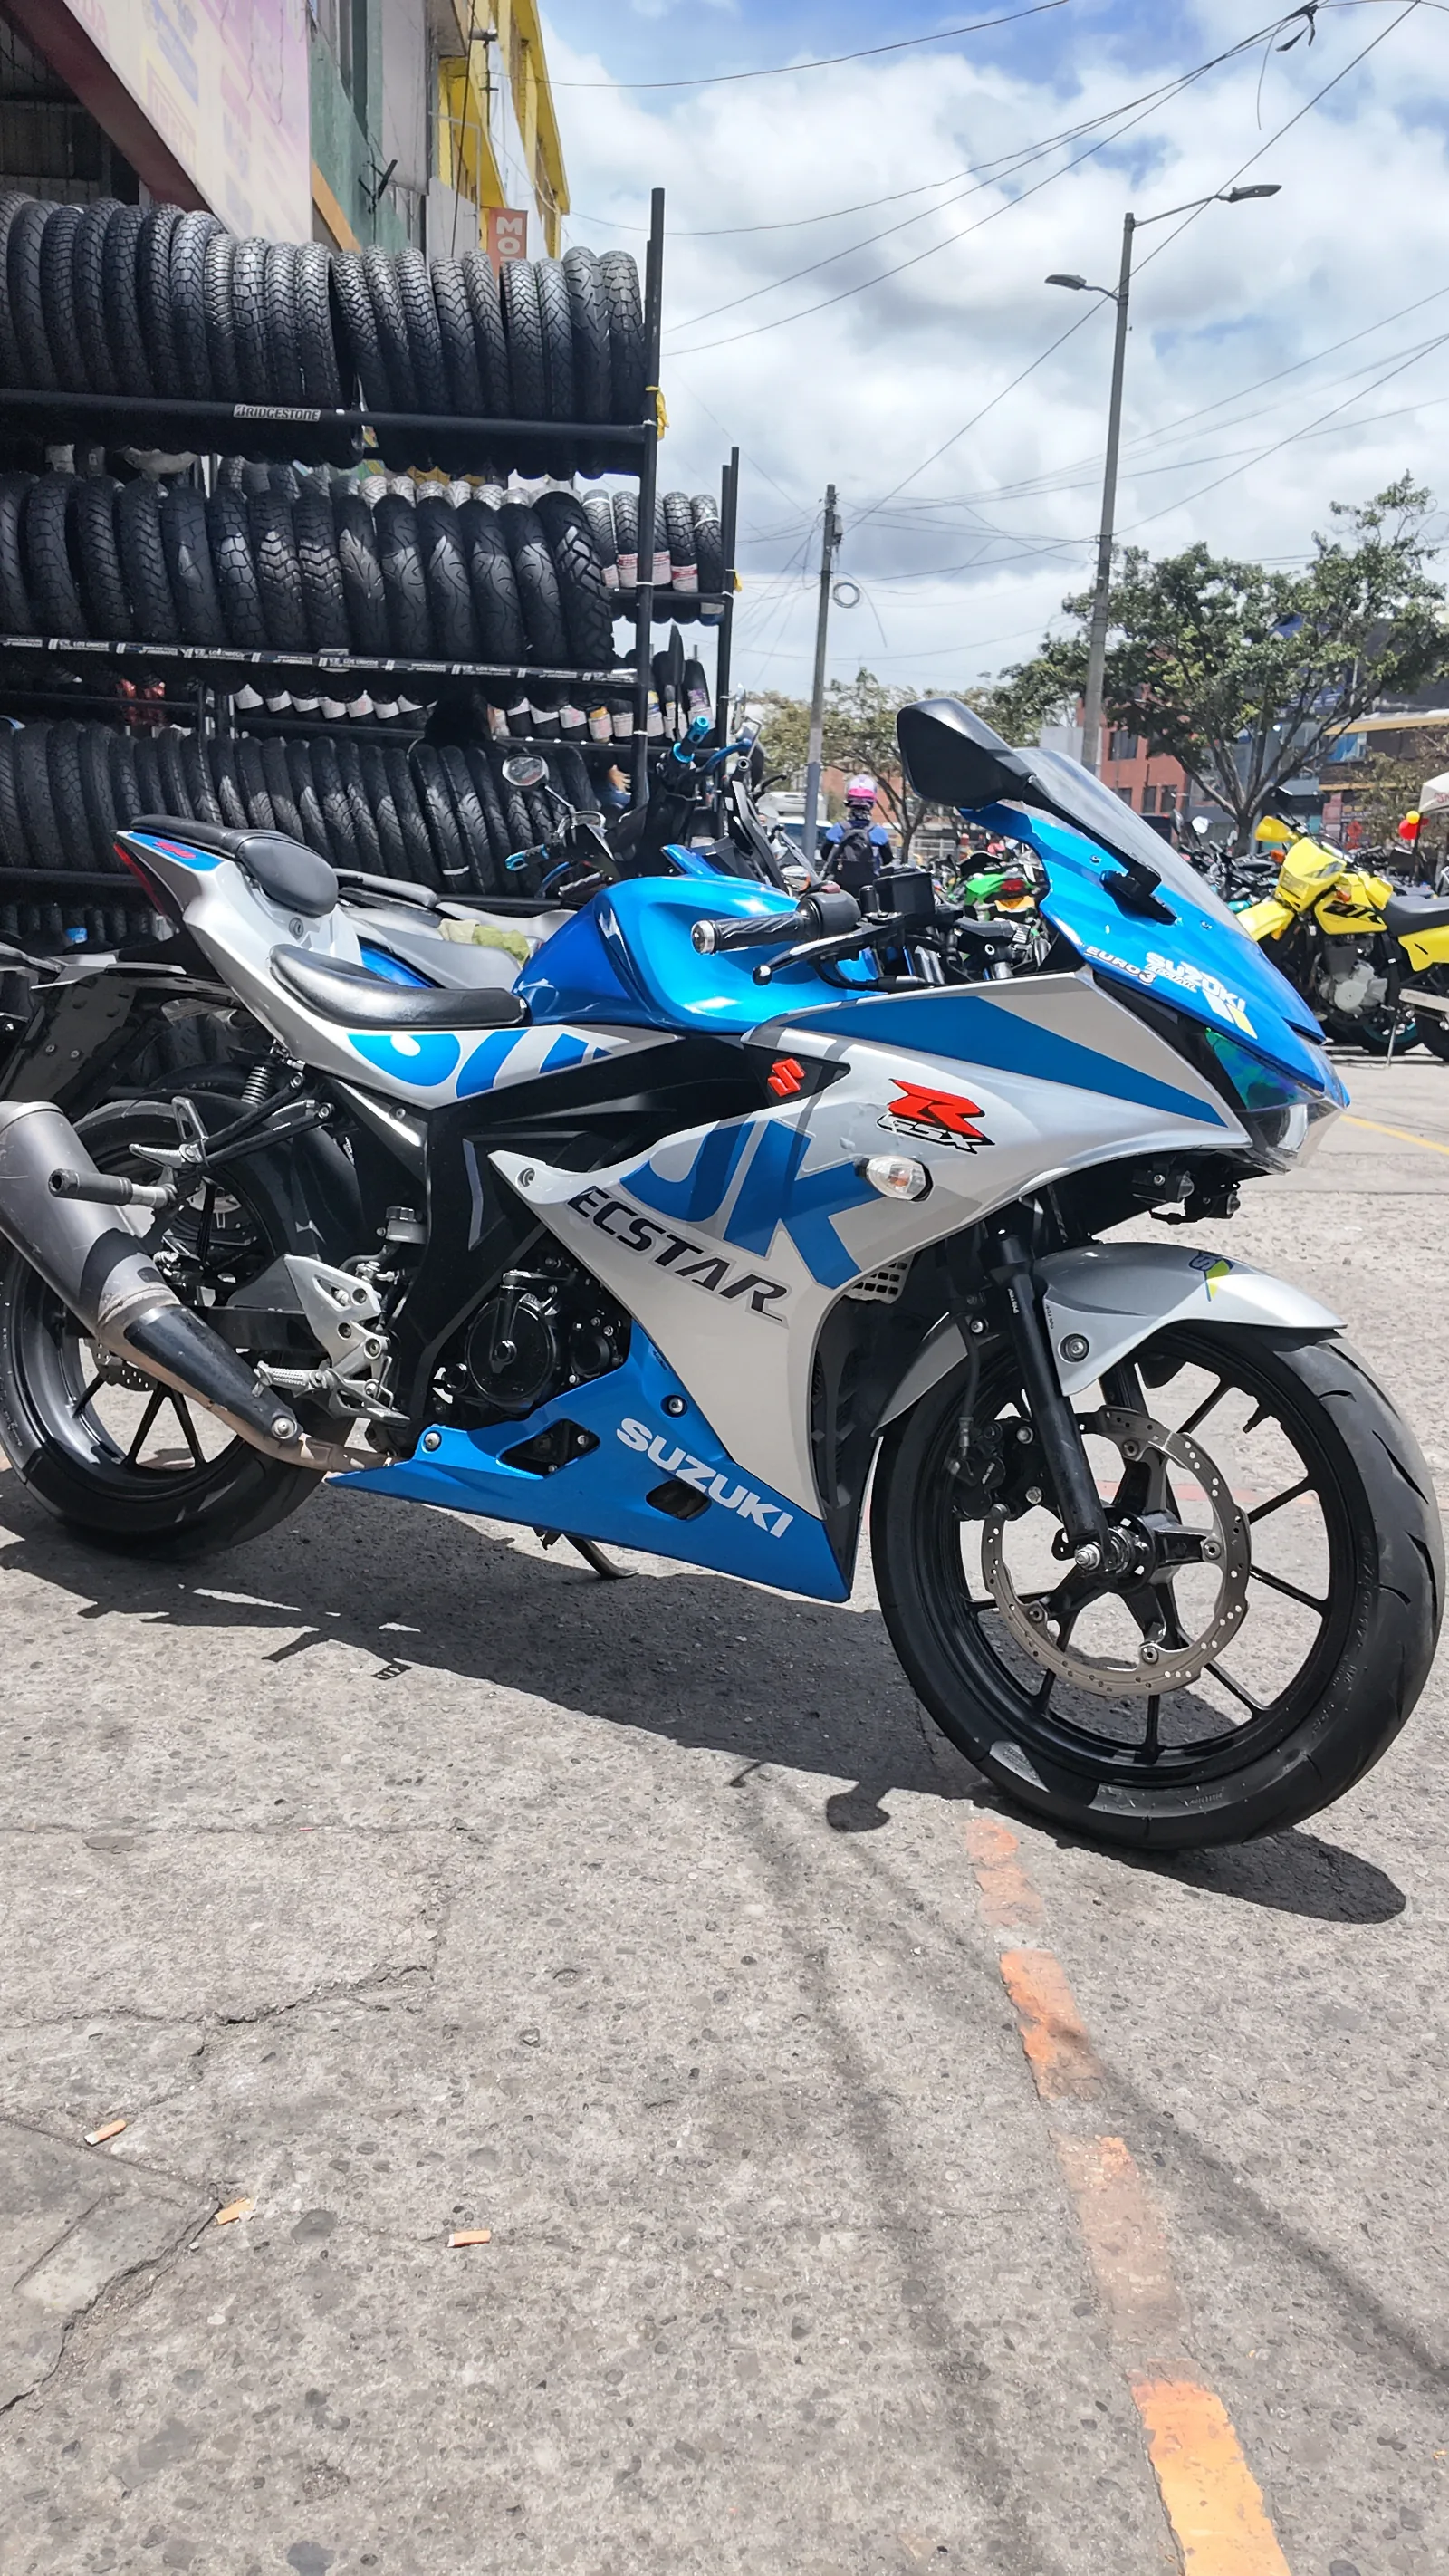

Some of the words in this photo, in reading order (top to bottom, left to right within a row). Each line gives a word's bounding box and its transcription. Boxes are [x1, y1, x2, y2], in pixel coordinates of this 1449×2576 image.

[496, 216, 523, 264] MO
[236, 405, 320, 421] BRIDGESTONE
[1146, 951, 1246, 1014] SUZUKI
[567, 1186, 787, 1322] ECSTAR
[616, 1418, 794, 1538] SUZUKI
